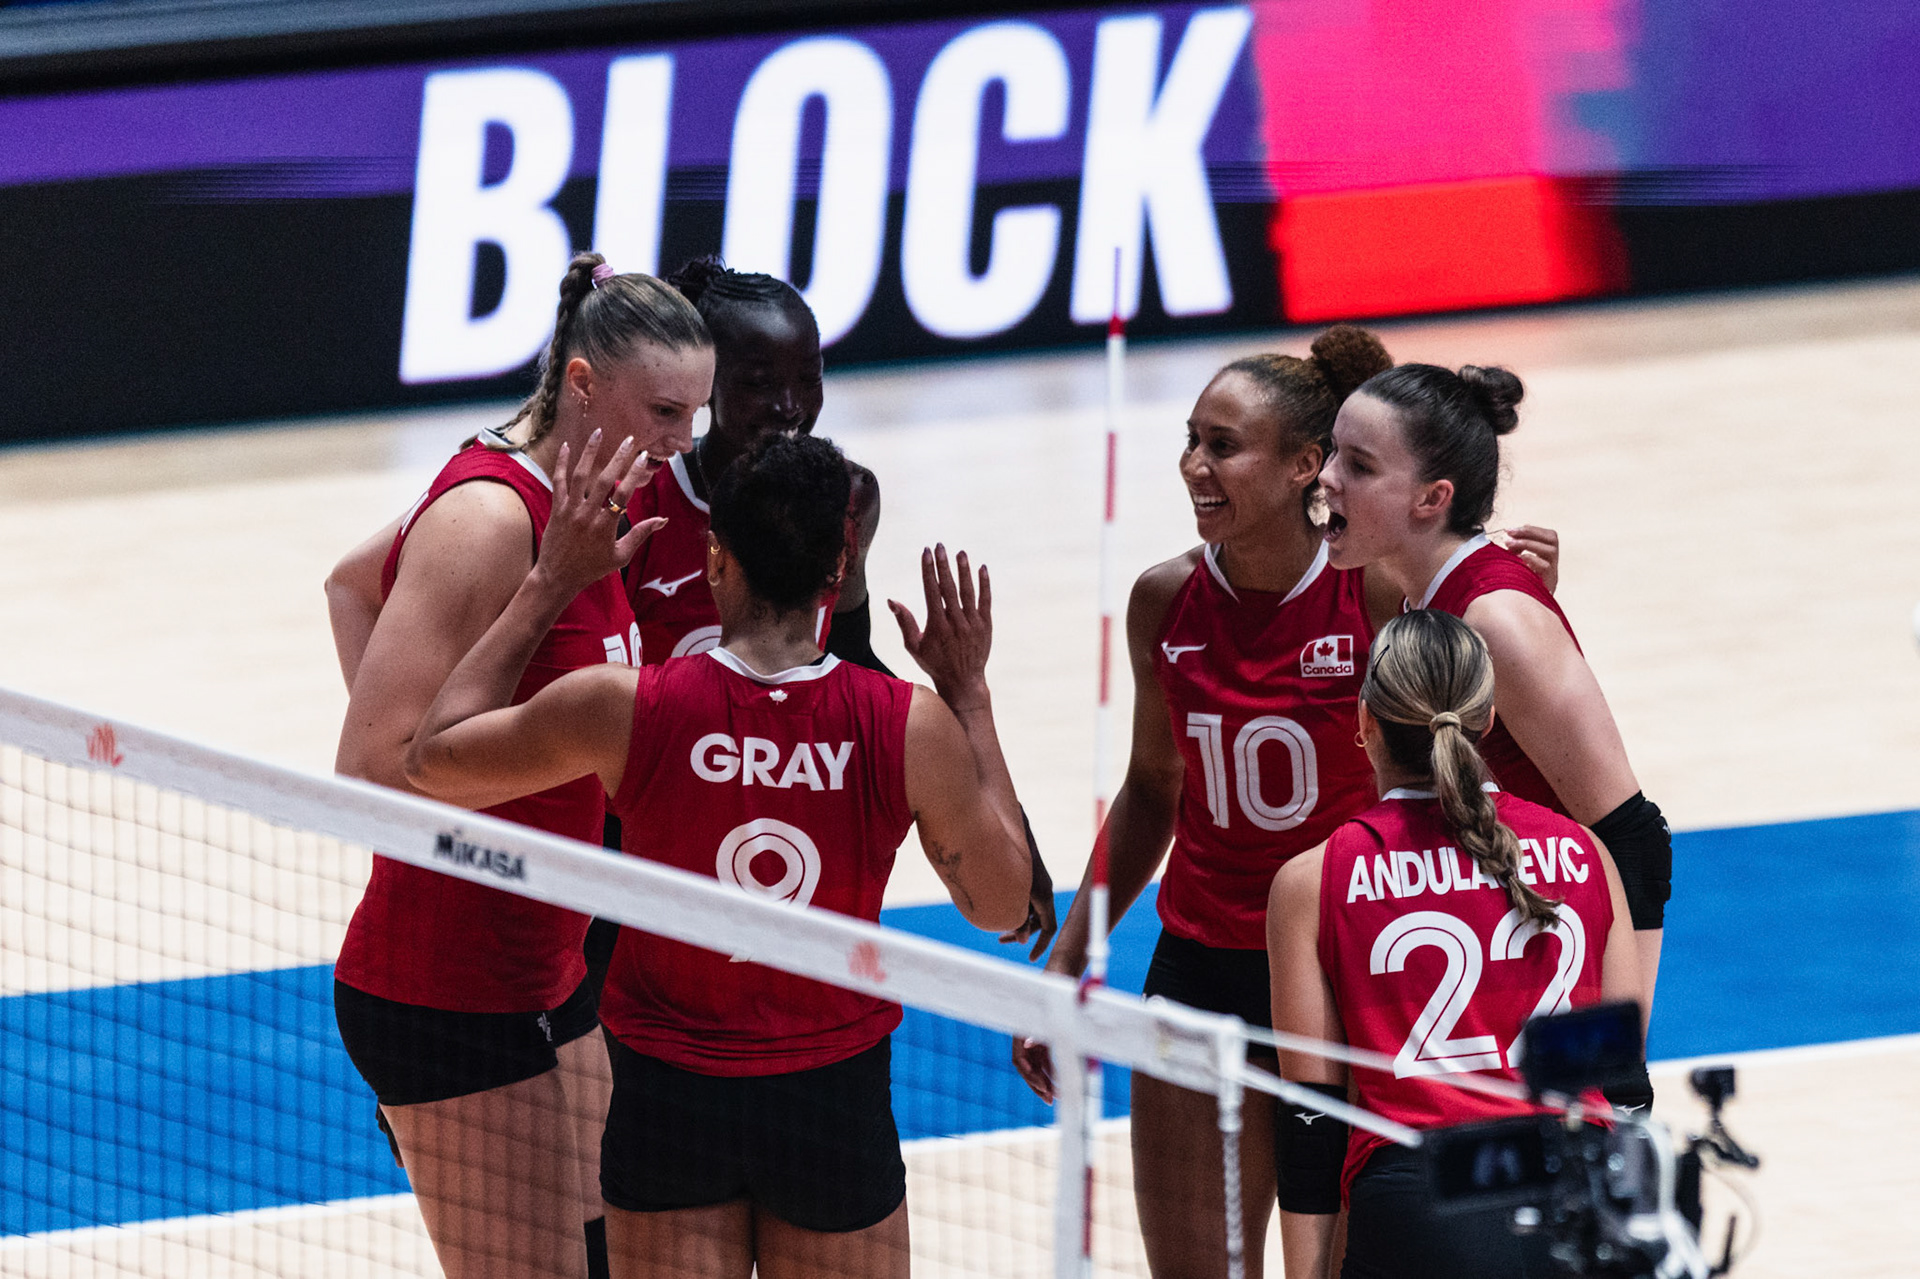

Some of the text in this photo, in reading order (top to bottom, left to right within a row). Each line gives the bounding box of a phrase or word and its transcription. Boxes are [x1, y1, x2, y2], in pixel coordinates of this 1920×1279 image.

[400, 6, 1254, 384] BLOCK
[1303, 664, 1352, 675] Canada
[689, 732, 855, 792] GRAY
[1186, 712, 1319, 832] 10
[1346, 836, 1590, 904] ANDULAEVIC
[1369, 900, 1587, 1080] 22
